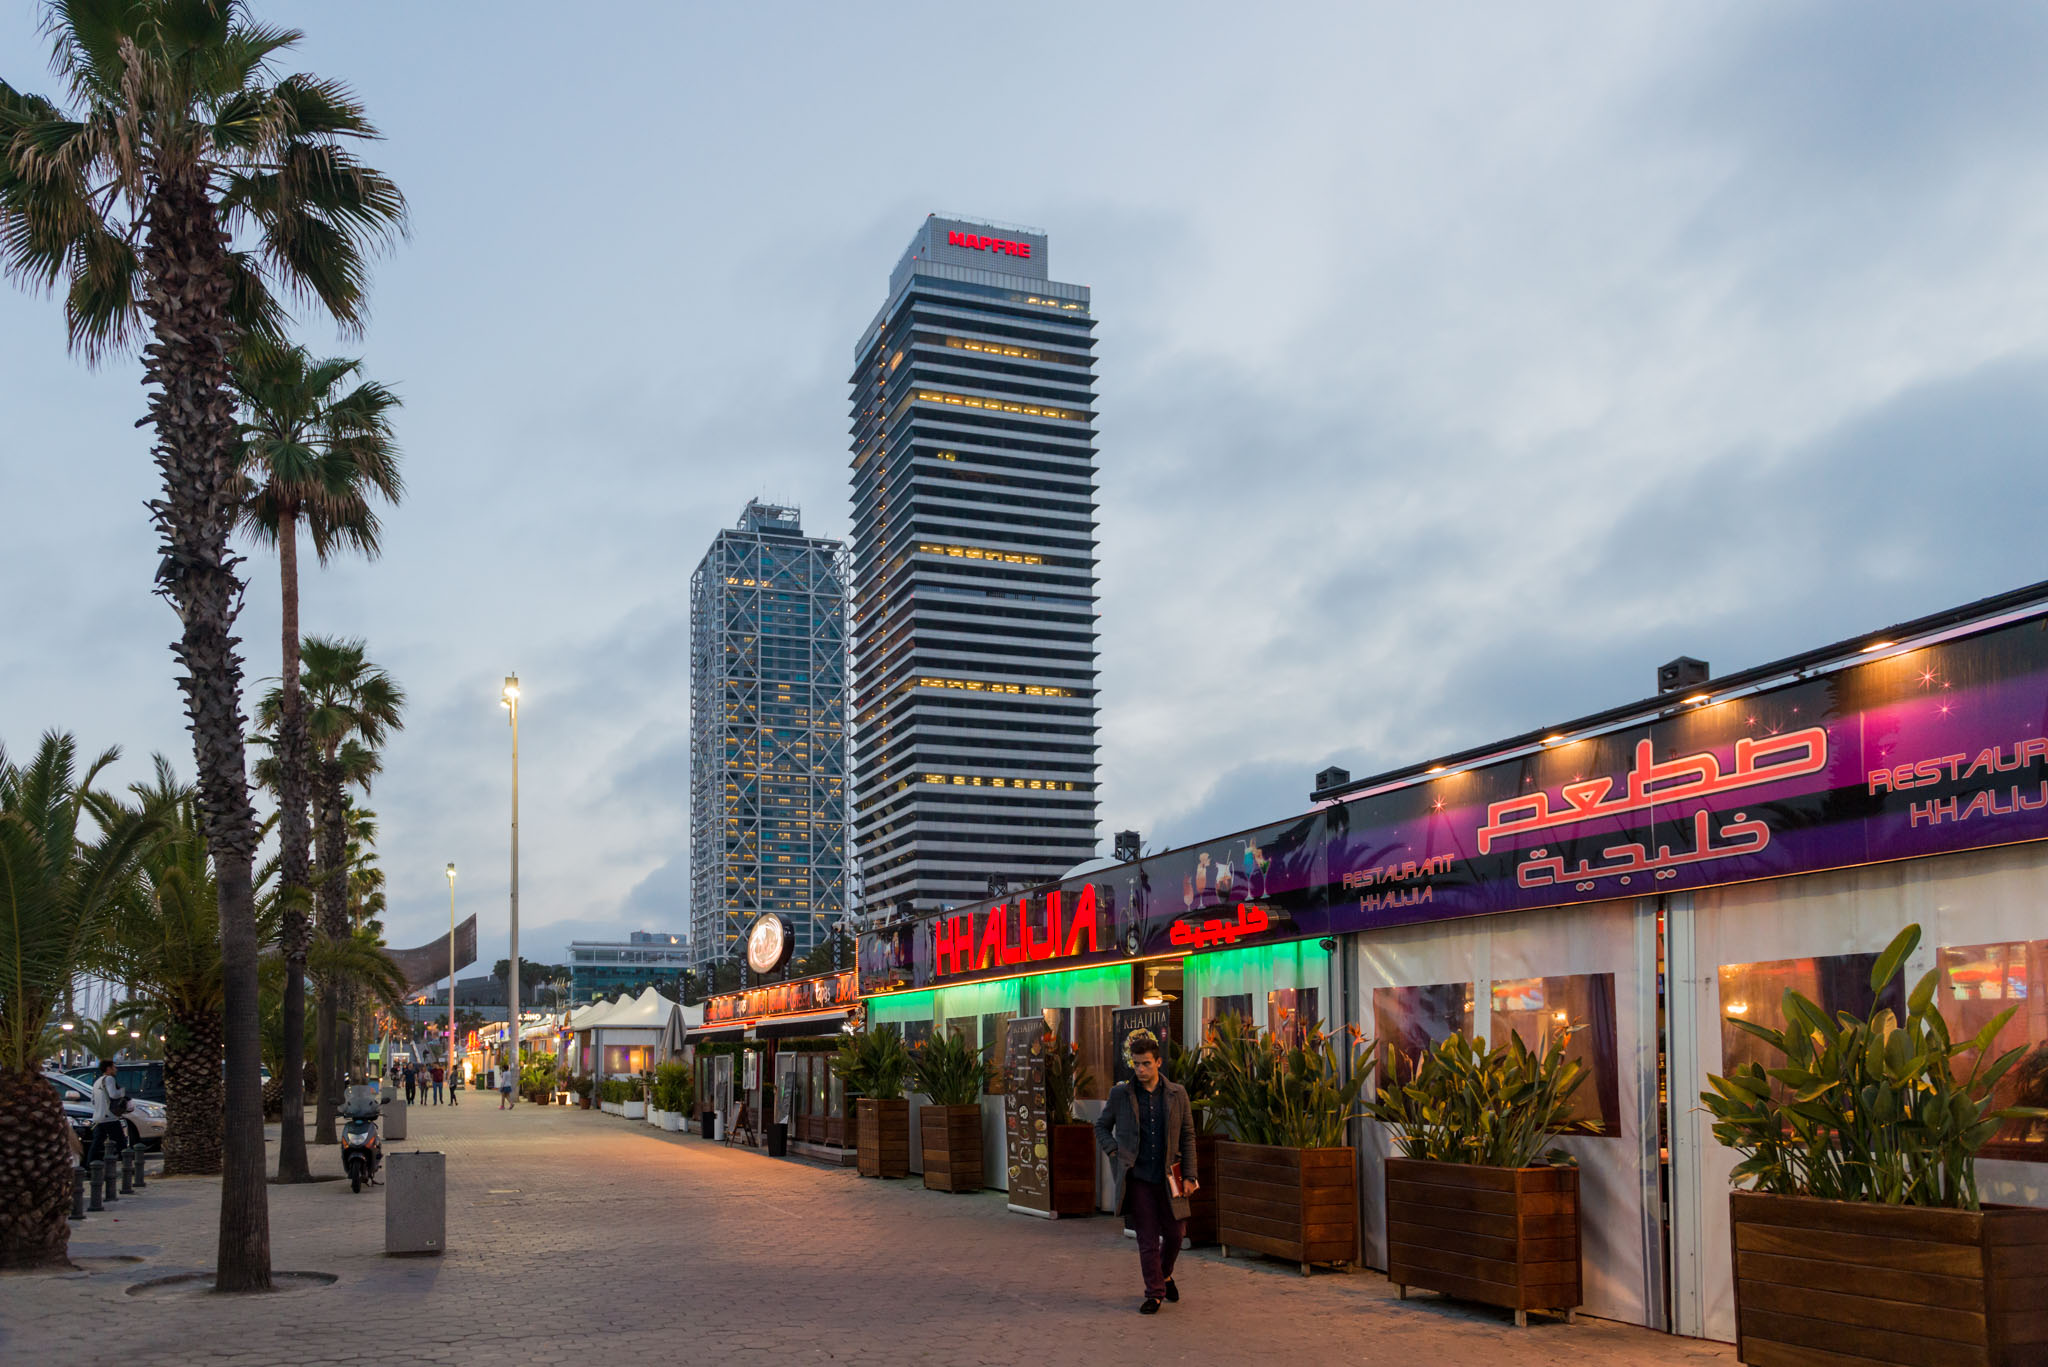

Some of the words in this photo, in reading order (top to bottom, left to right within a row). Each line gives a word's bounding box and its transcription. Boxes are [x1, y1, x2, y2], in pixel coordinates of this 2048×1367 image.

[948, 230, 1031, 258] MAPFRE
[1517, 809, 1770, 892] خليجية
[1342, 853, 1455, 890] RESTAURANT
[1360, 885, 1433, 913] KHALIJIA
[935, 882, 1098, 976] KHALIJIA
